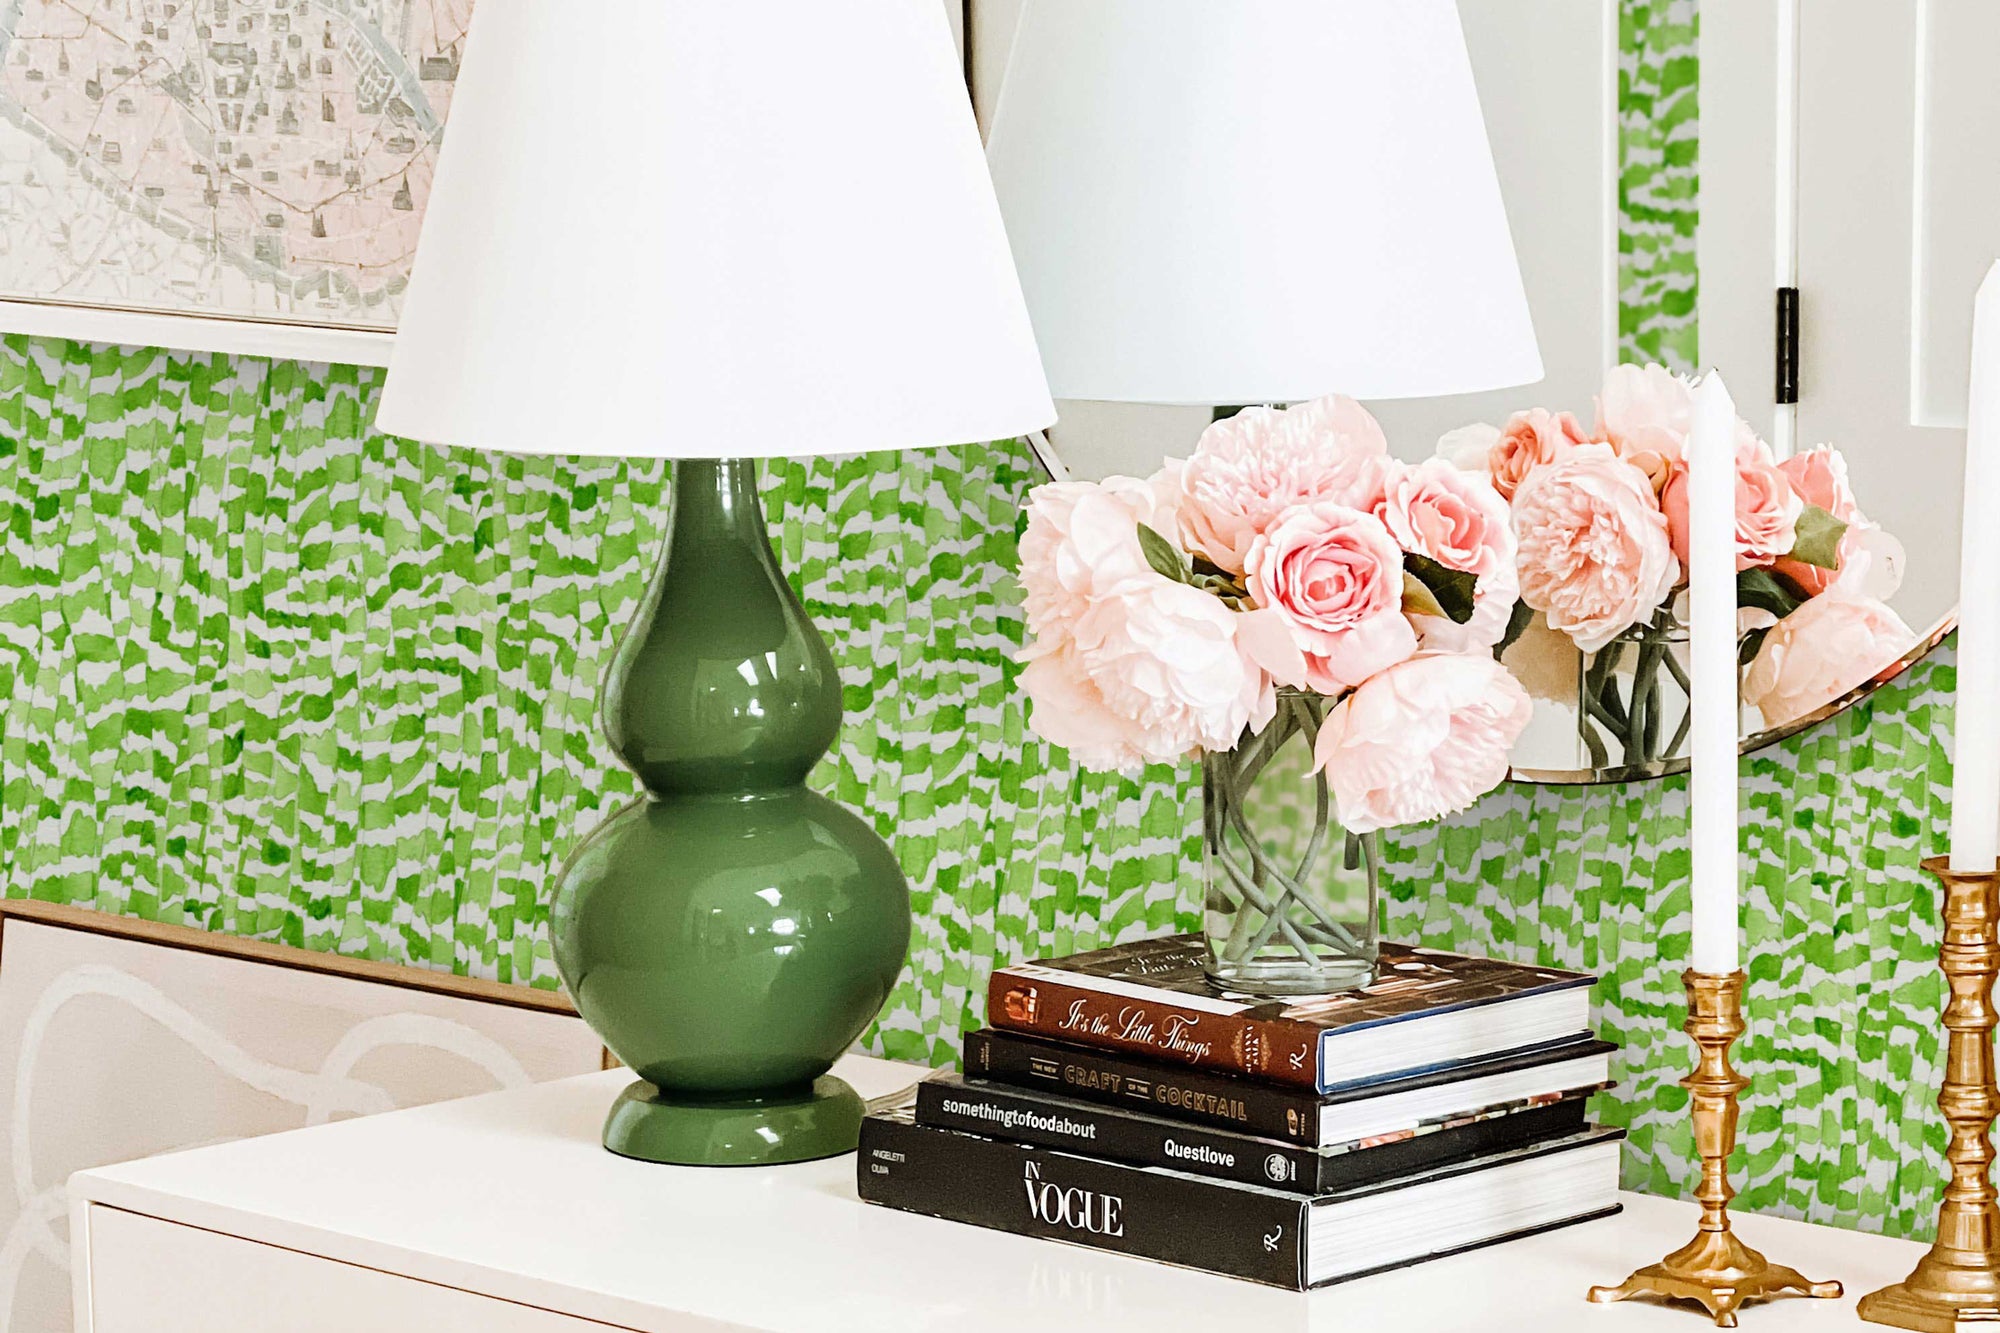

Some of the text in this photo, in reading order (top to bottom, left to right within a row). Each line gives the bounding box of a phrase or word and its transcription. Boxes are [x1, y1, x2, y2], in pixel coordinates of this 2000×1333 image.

[1058, 999, 1212, 1064] It's the Little Things
[1064, 1065, 1121, 1093] CRAFT
[1155, 1084, 1248, 1121] COCKTAIL
[942, 1099, 1096, 1139] somethingtofoodabout
[1025, 1160, 1041, 1180] IN
[1164, 1138, 1235, 1167] Questlove
[1024, 1179, 1123, 1237] VOGUE
